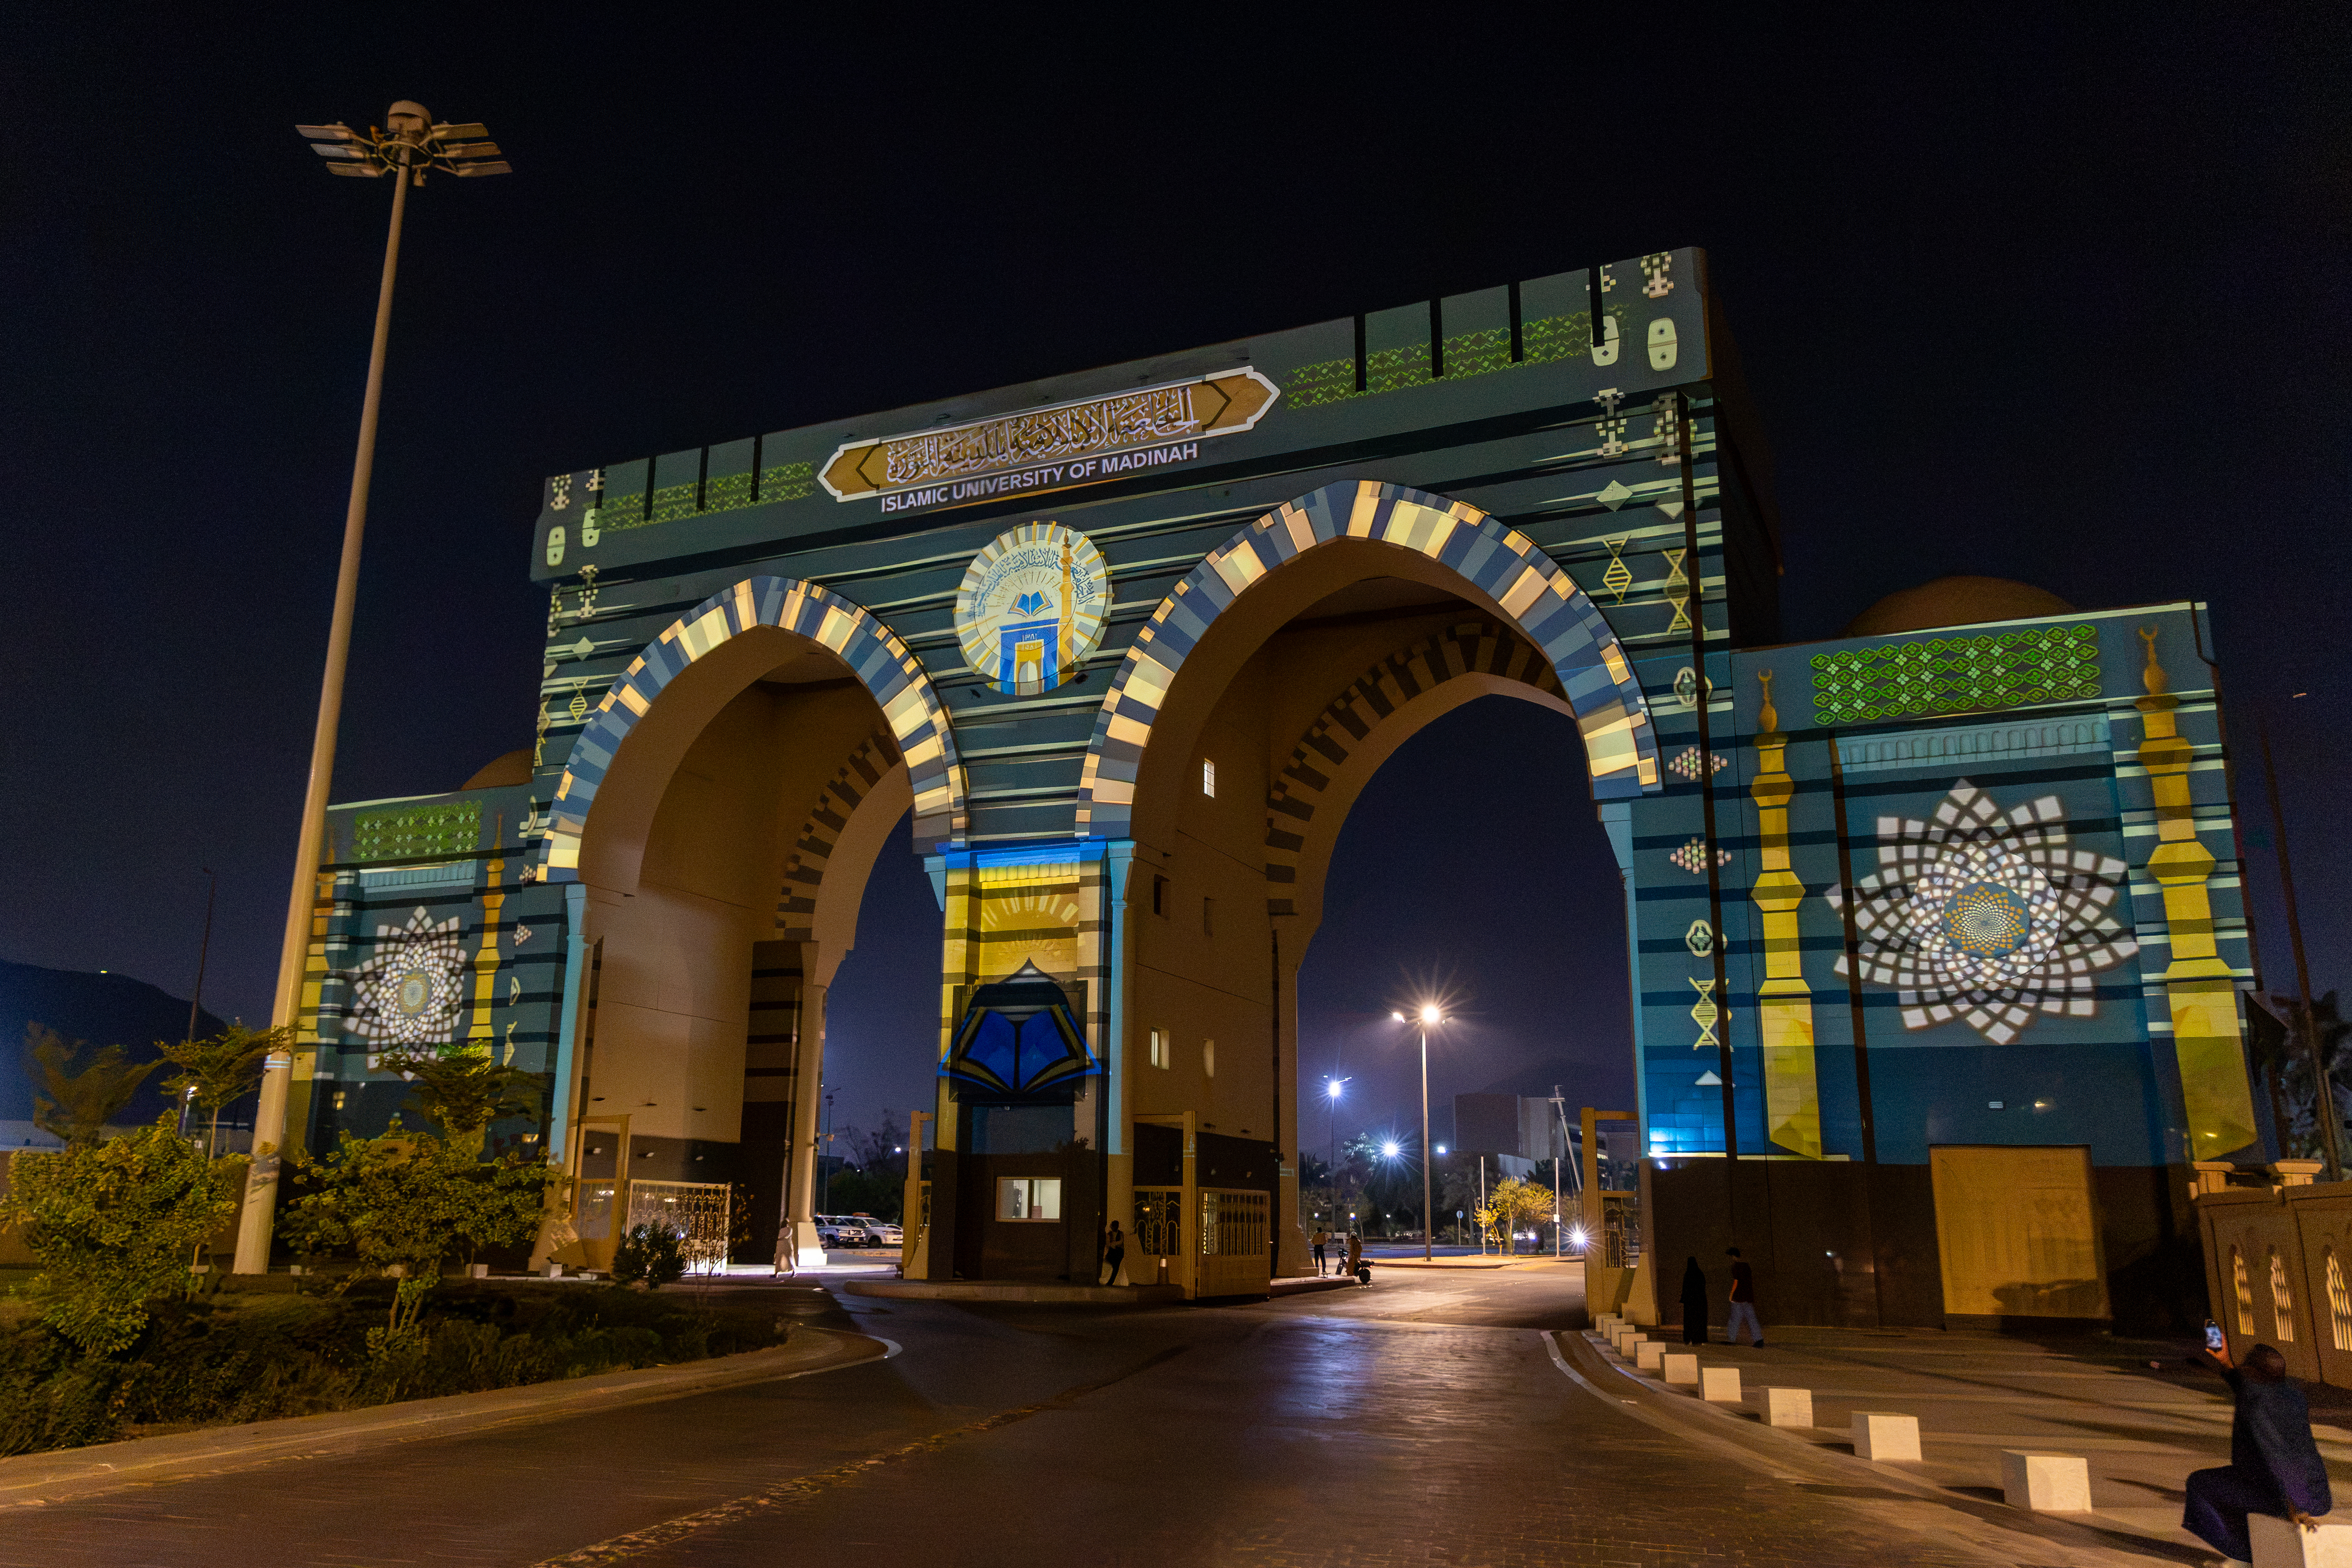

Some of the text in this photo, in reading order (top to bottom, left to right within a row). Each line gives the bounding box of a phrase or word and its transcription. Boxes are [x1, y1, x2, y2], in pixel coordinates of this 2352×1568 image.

[881, 443, 1198, 513] ISLAMIC UNIVERSITY OF MADINAH
